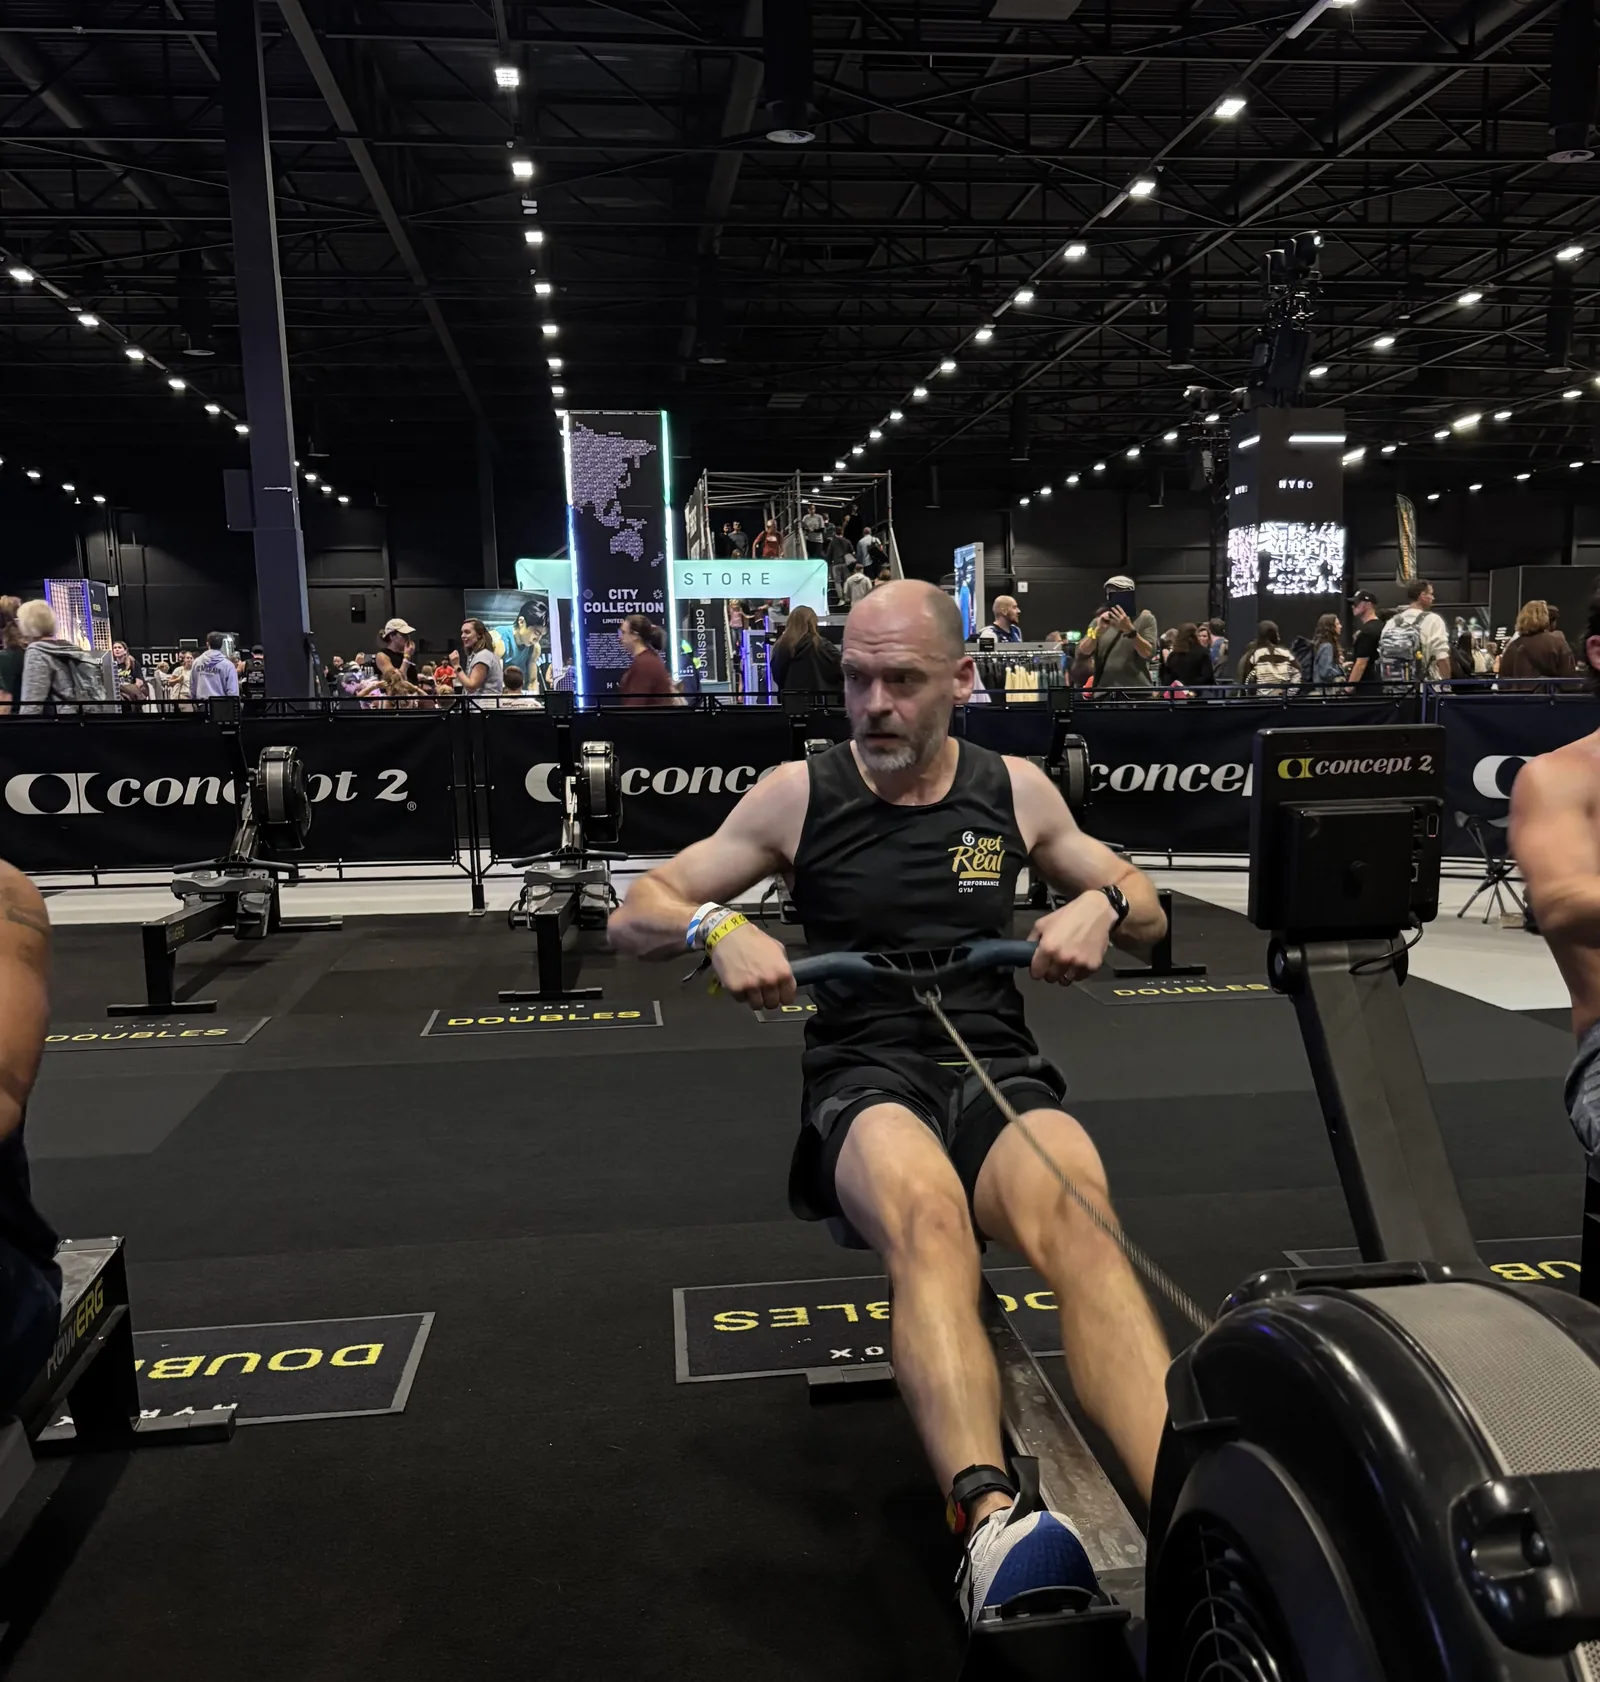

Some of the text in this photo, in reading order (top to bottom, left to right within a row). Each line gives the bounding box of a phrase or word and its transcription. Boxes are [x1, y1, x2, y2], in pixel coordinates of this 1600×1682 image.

[683, 572, 771, 586] STORE
[608, 588, 639, 600] CITY
[583, 602, 665, 613] COLLECTION
[695, 608, 709, 668] CROSSING
[141, 653, 182, 666] REFU
[1315, 754, 1433, 776] concept 2
[374, 768, 409, 802] 2
[620, 765, 783, 796] conc
[1090, 762, 1254, 797] conce
[974, 835, 1004, 856] get
[947, 846, 1006, 873] Real
[1113, 983, 1270, 997] DOUBLES
[447, 1010, 642, 1026] DOUBLES
[44, 1028, 230, 1042] DOUBLES
[135, 1343, 385, 1380] DOUB
